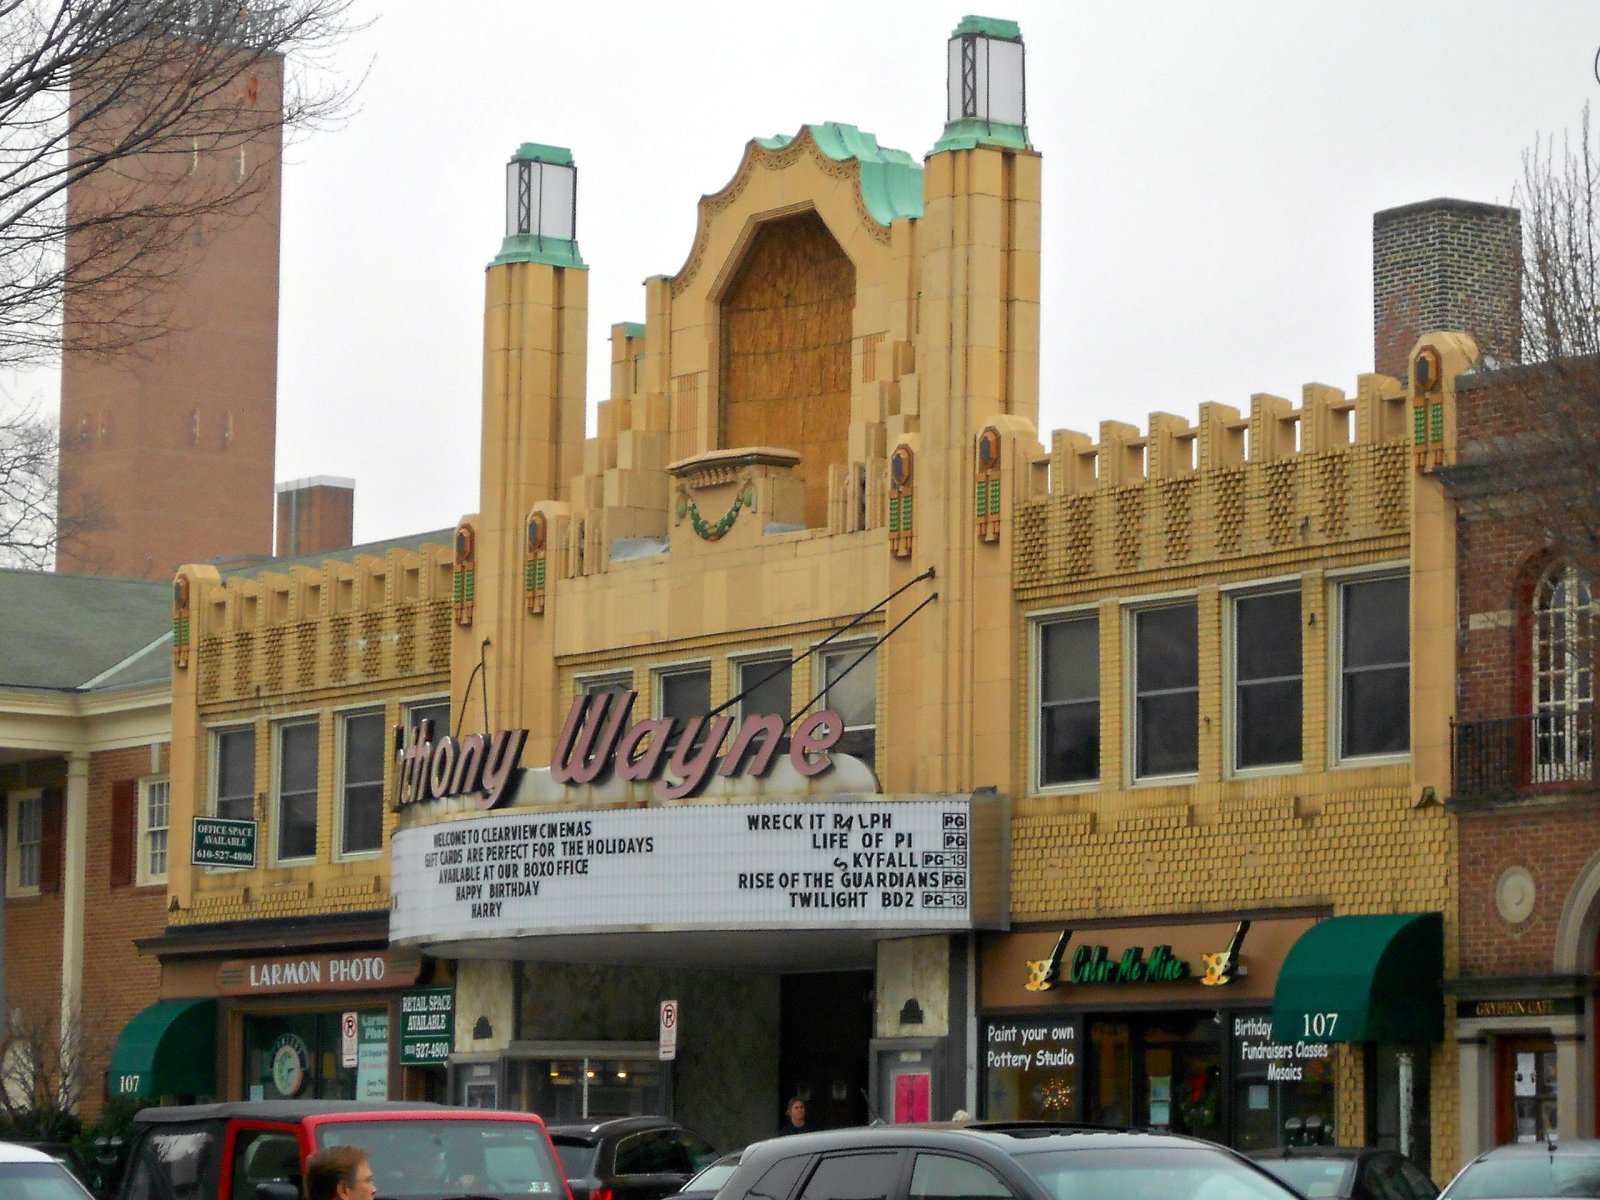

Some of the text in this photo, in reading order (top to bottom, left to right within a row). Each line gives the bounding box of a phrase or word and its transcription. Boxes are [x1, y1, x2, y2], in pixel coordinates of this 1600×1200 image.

[550, 689, 846, 799] Wayne
[198, 825, 253, 837] OFFICE SPACE
[747, 811, 965, 831] WRECK IT RALPH PG
[203, 836, 247, 847] AVAILABLE
[433, 821, 592, 848] WELCOME TO CLEARVIEW CINEMAS
[812, 832, 966, 849] LIFE OF PI PG
[196, 850, 253, 861] 610-527-4800
[424, 837, 654, 868] GIFT CARDS ARE PERFECT FOR THE HOLIDAYS
[833, 852, 966, 872] SKYFALL PG-13
[438, 866, 481, 884] AVAILABLE
[483, 865, 494, 880] AT
[497, 863, 519, 879] OUR
[738, 871, 964, 889] RISE OF THE GUARDIANS PG
[456, 881, 540, 901] HAPPY BIRTHDAY
[789, 891, 966, 908] TWILIGHT BD2 PG-13
[471, 902, 502, 918] HARRY
[250, 957, 385, 986] LARMON PHOTO
[402, 995, 451, 1012] RETAIL SPACE
[407, 1014, 447, 1031] AVAILABLE
[1234, 1017, 1272, 1040] Birthday
[1303, 1013, 1338, 1036] 107
[988, 1025, 1074, 1046] Paint your own
[415, 1042, 449, 1058] 527-4800
[987, 1048, 1074, 1072] Pottery Studio
[1242, 1040, 1328, 1060] Fundraisers Classes
[1267, 1063, 1302, 1081] Mosaics
[120, 1075, 140, 1092] 107
